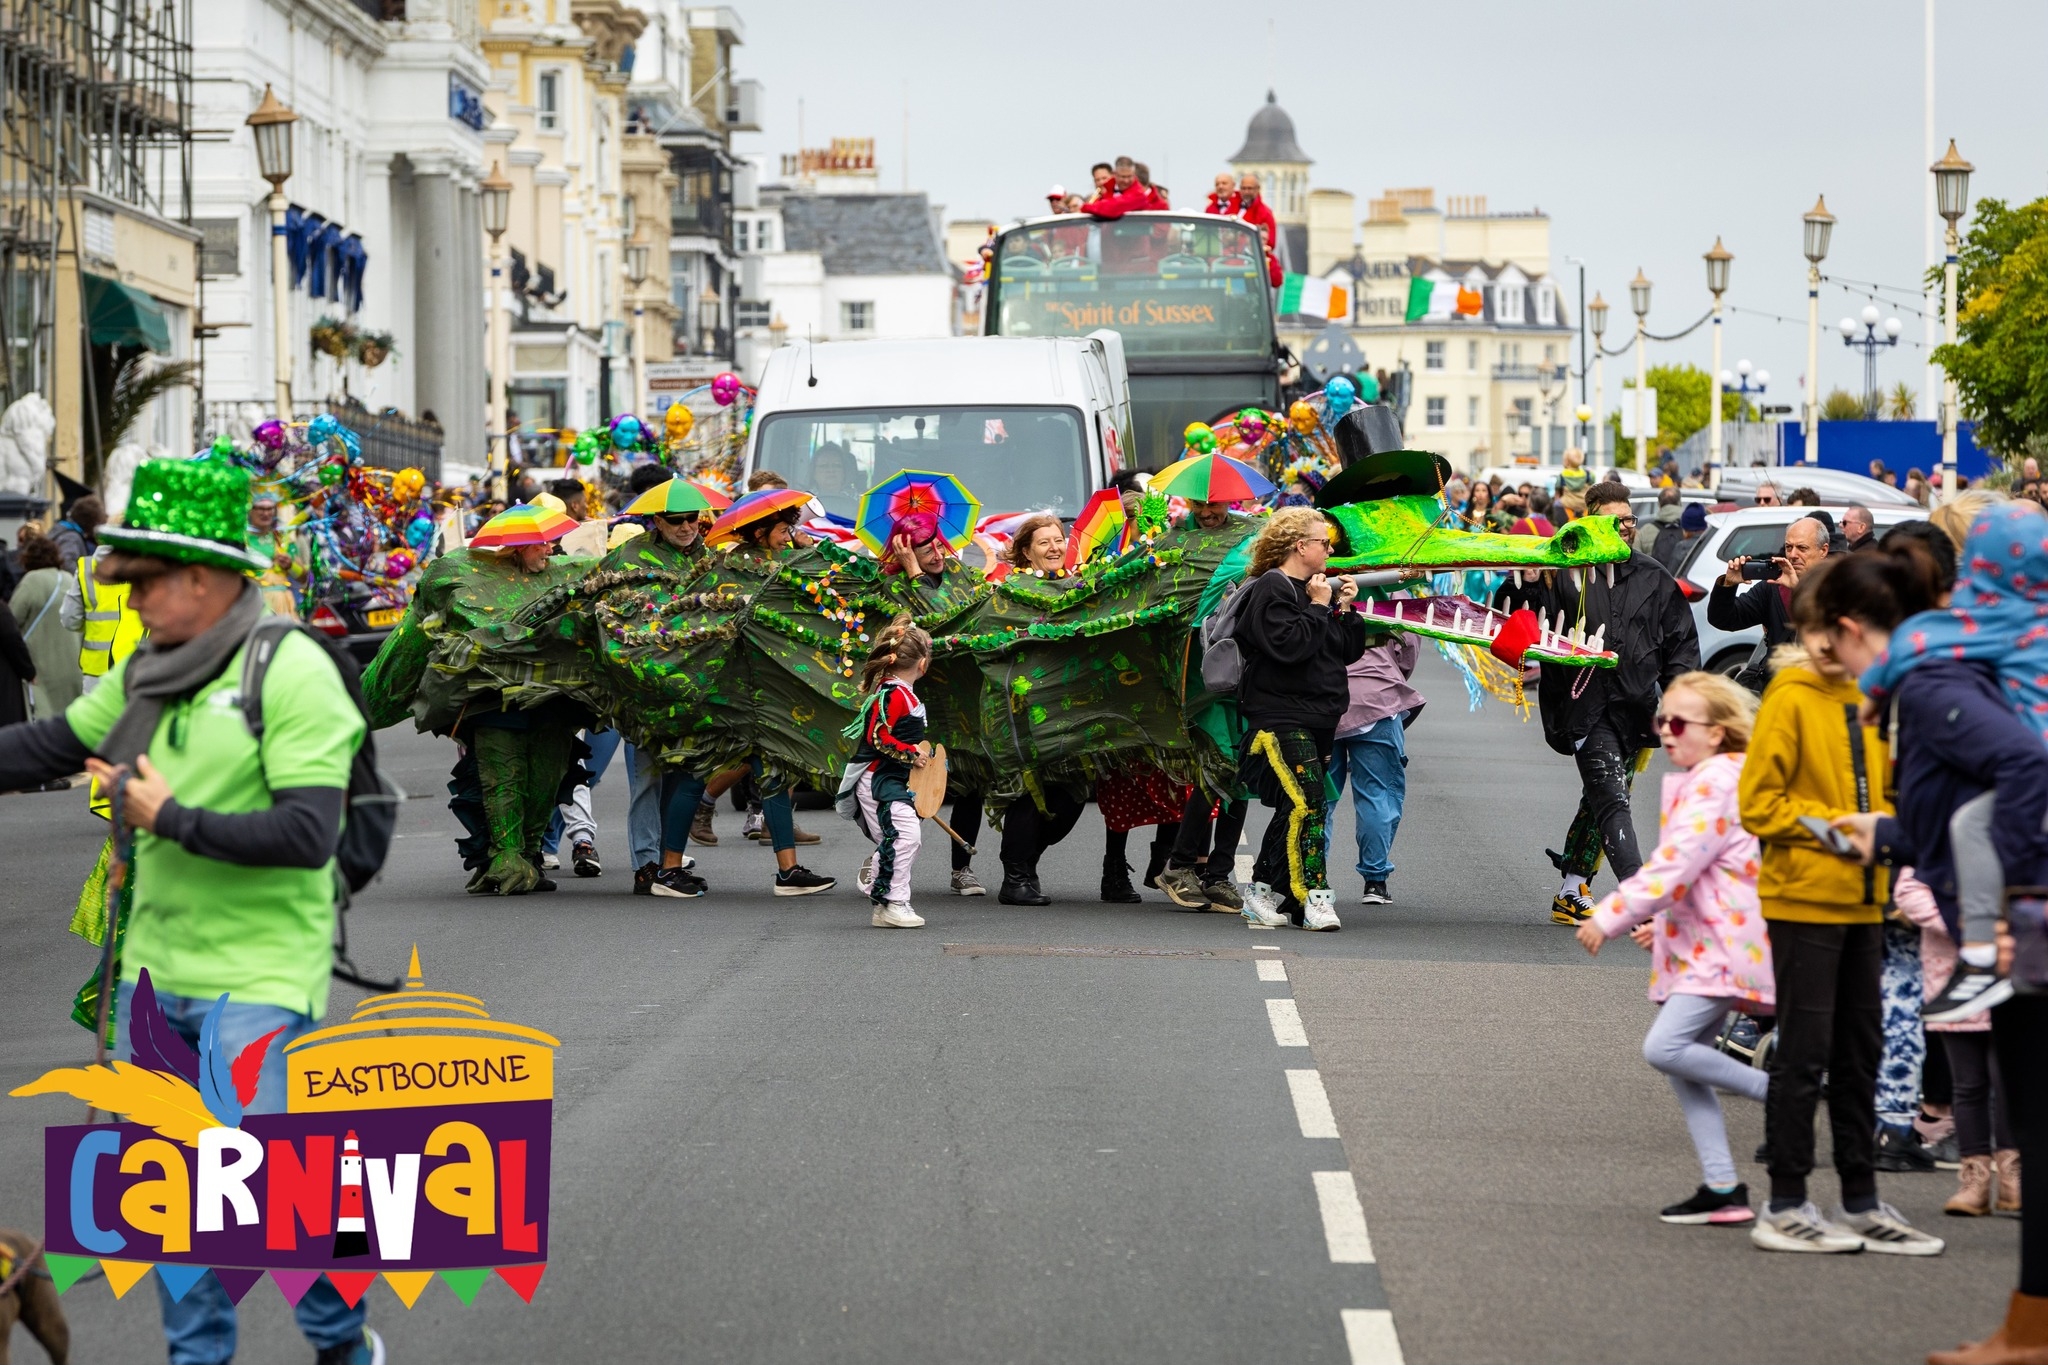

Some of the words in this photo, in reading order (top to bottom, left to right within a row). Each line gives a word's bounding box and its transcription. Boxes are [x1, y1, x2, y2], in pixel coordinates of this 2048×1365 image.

[1061, 302, 1115, 331] Spirit
[1118, 300, 1140, 325] of
[1145, 300, 1215, 326] Sussex
